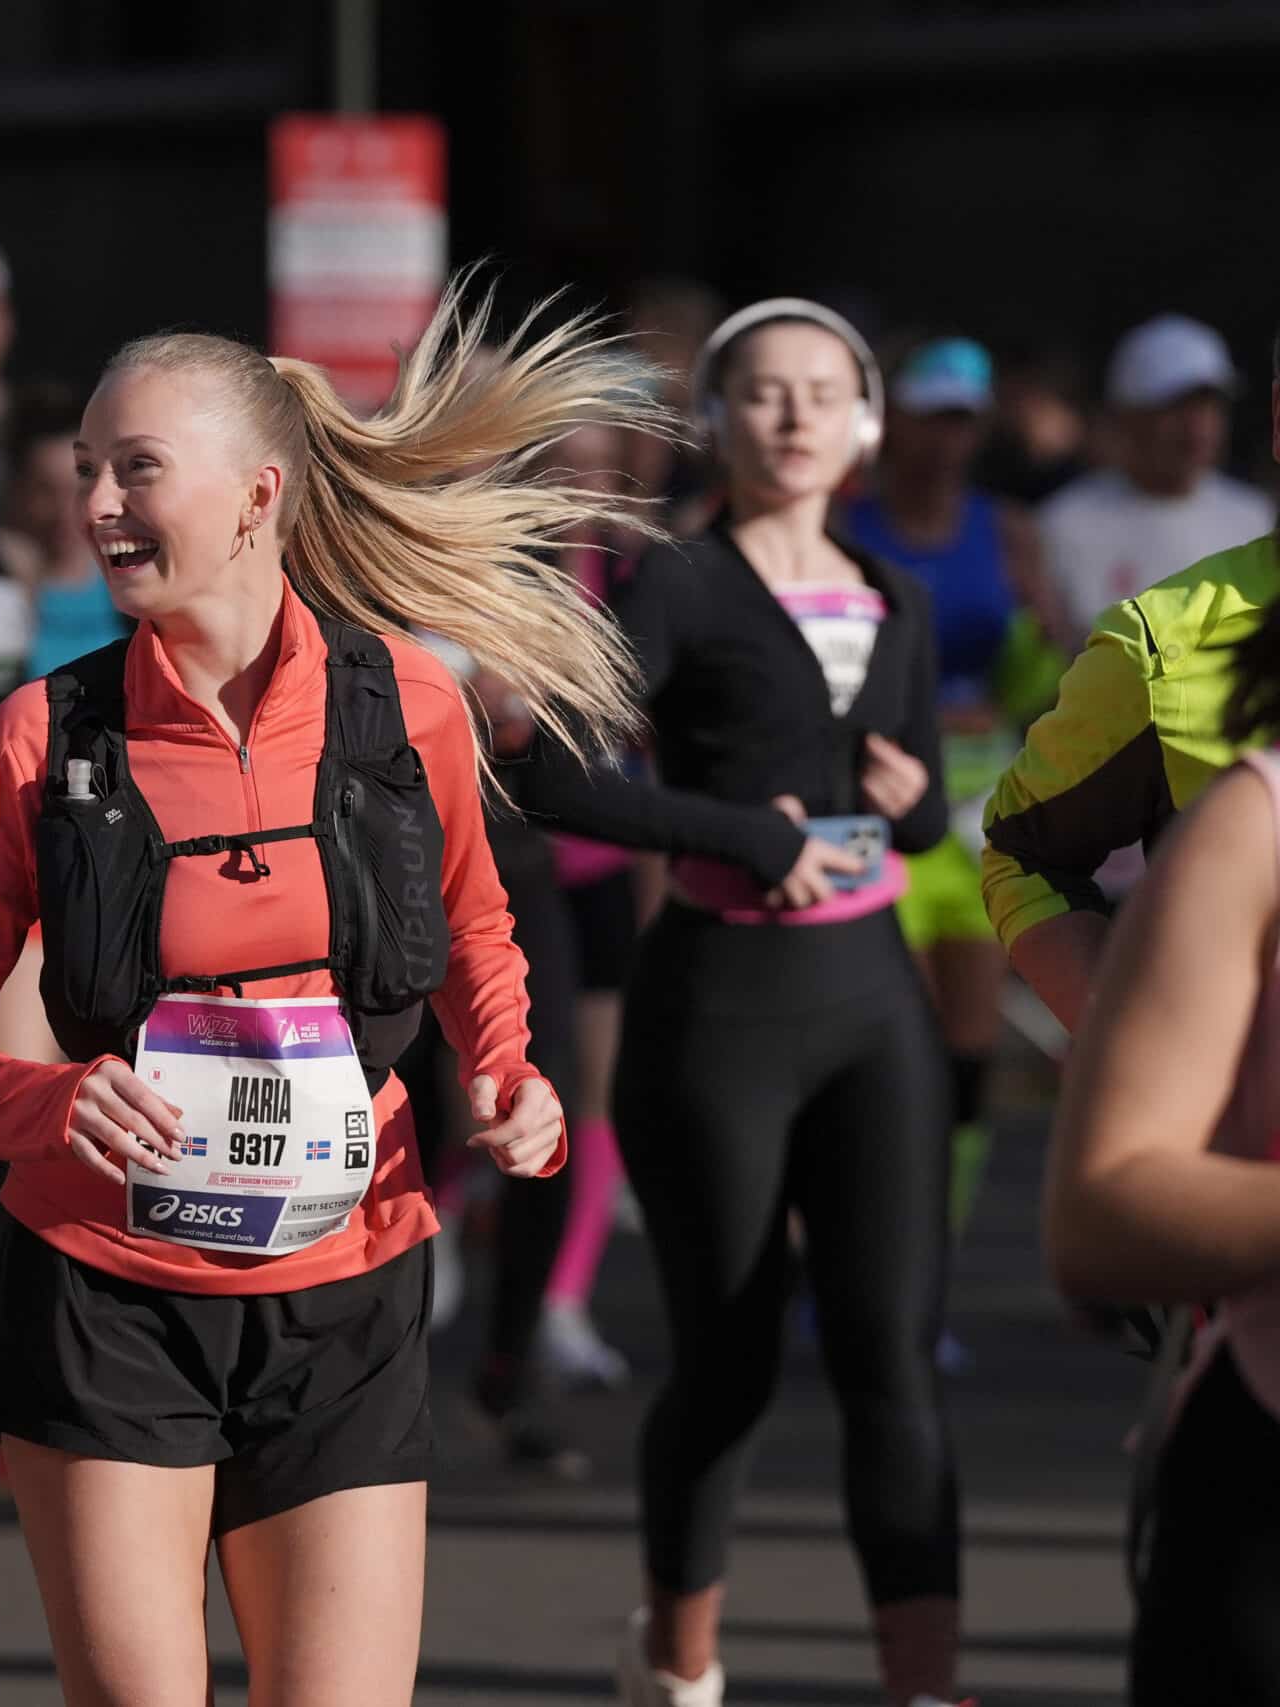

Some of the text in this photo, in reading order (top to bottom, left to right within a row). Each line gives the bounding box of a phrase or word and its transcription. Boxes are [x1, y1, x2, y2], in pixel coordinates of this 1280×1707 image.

[228, 1076, 291, 1124] MARIA
[229, 1132, 286, 1167] 9317
[292, 1203, 317, 1212] START
